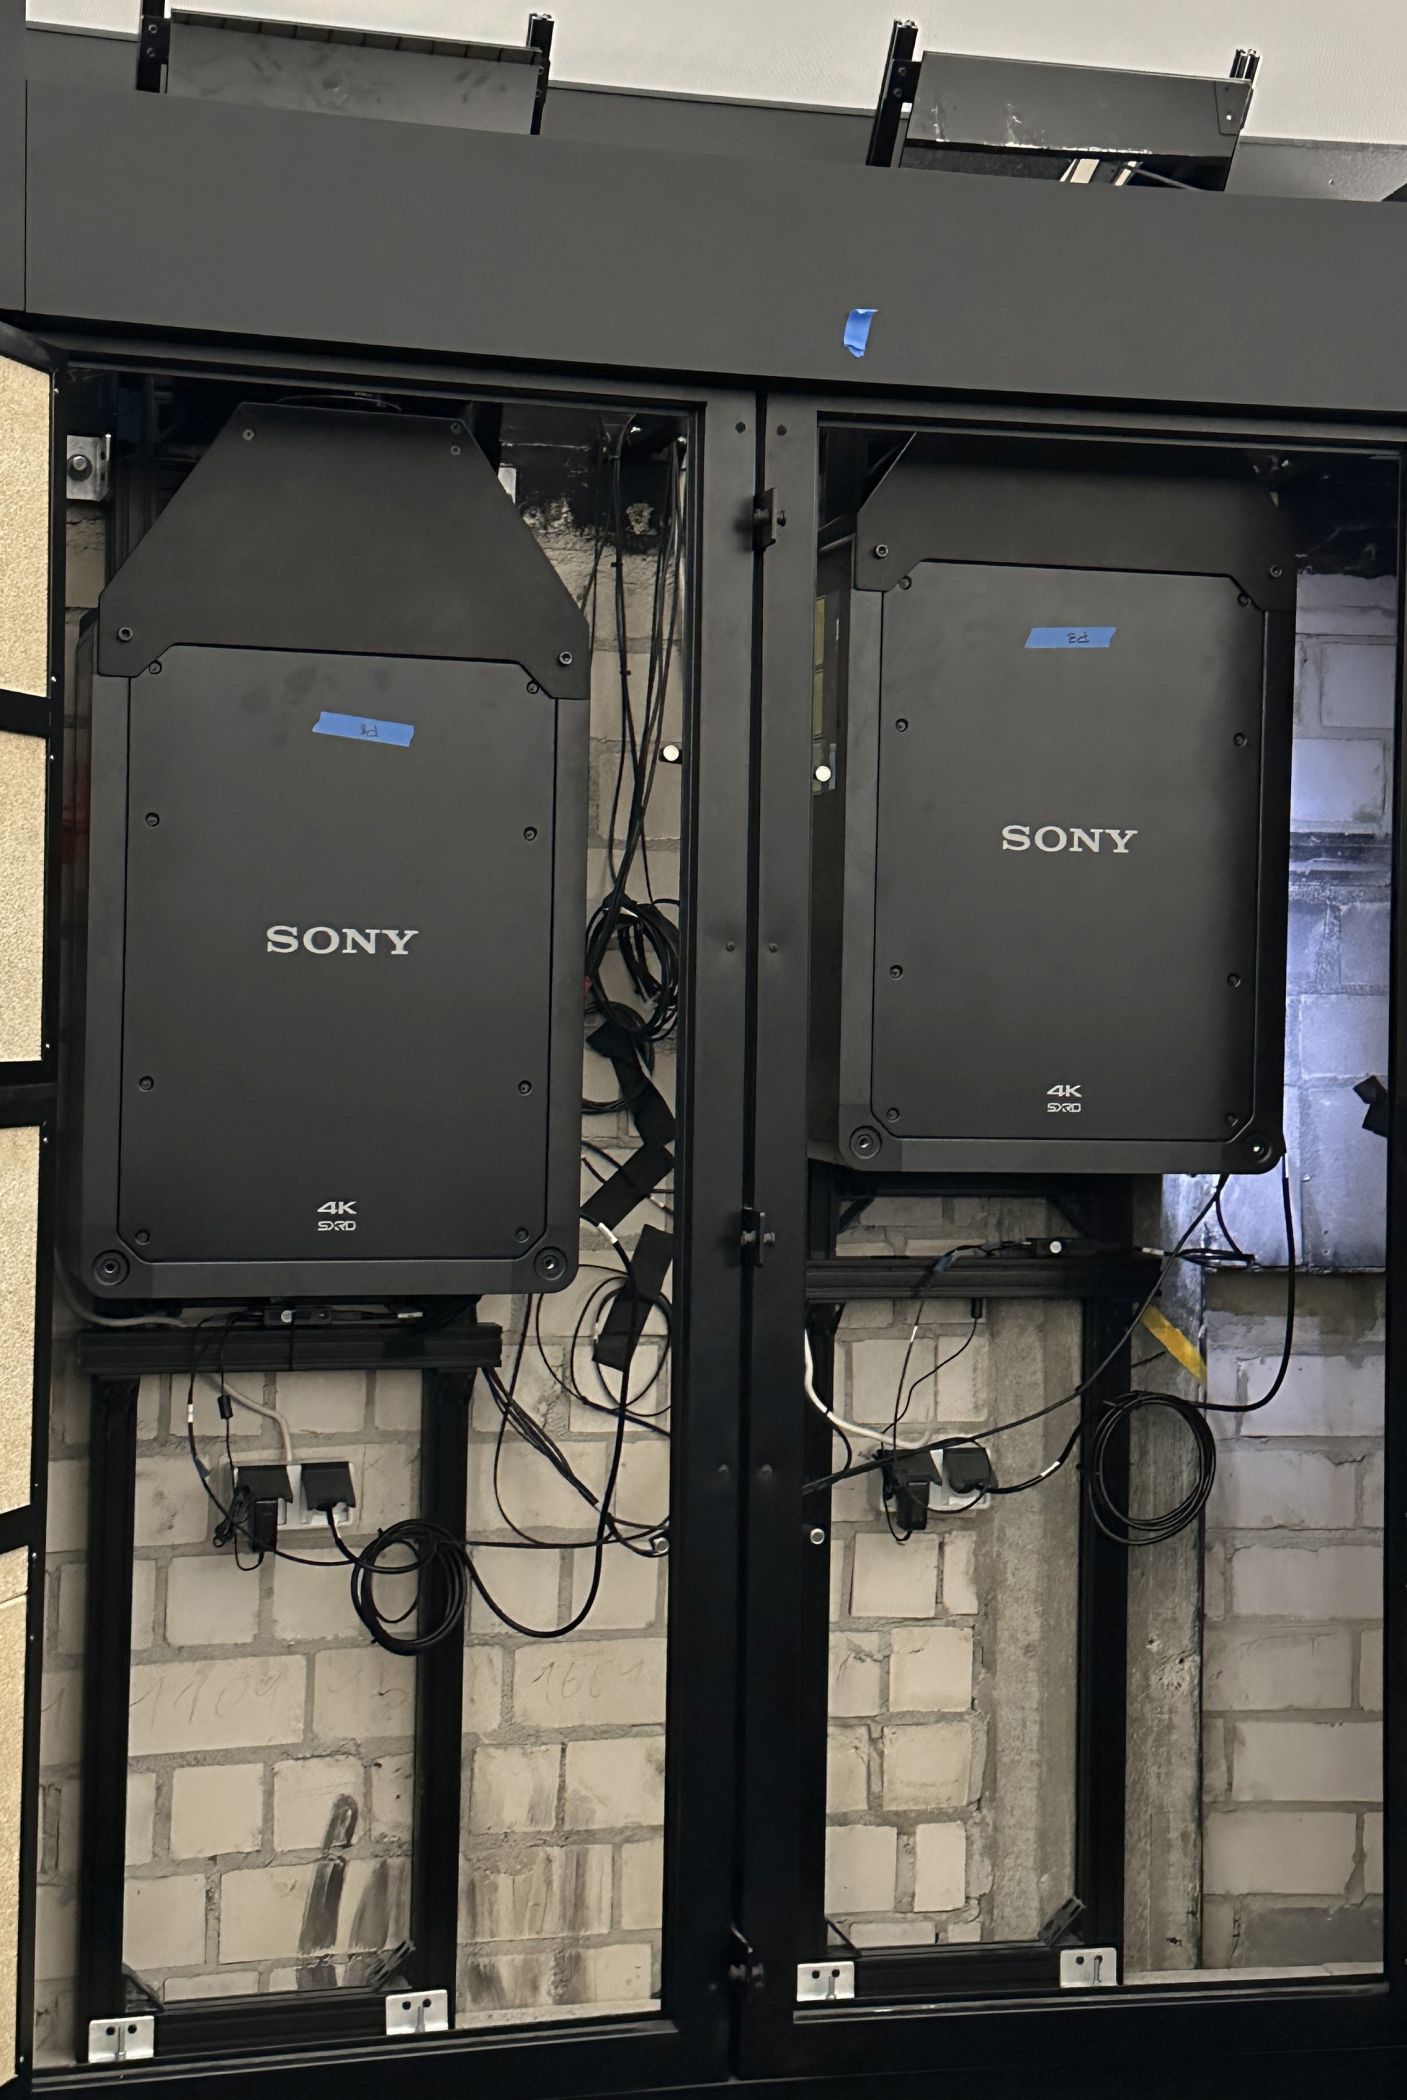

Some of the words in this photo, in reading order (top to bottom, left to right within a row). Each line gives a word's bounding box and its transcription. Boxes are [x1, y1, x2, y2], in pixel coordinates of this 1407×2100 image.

[1002, 825, 1139, 853] SONY
[266, 925, 419, 955] SONY
[1046, 1084, 1083, 1098] 4K
[317, 1201, 358, 1215] 4K
